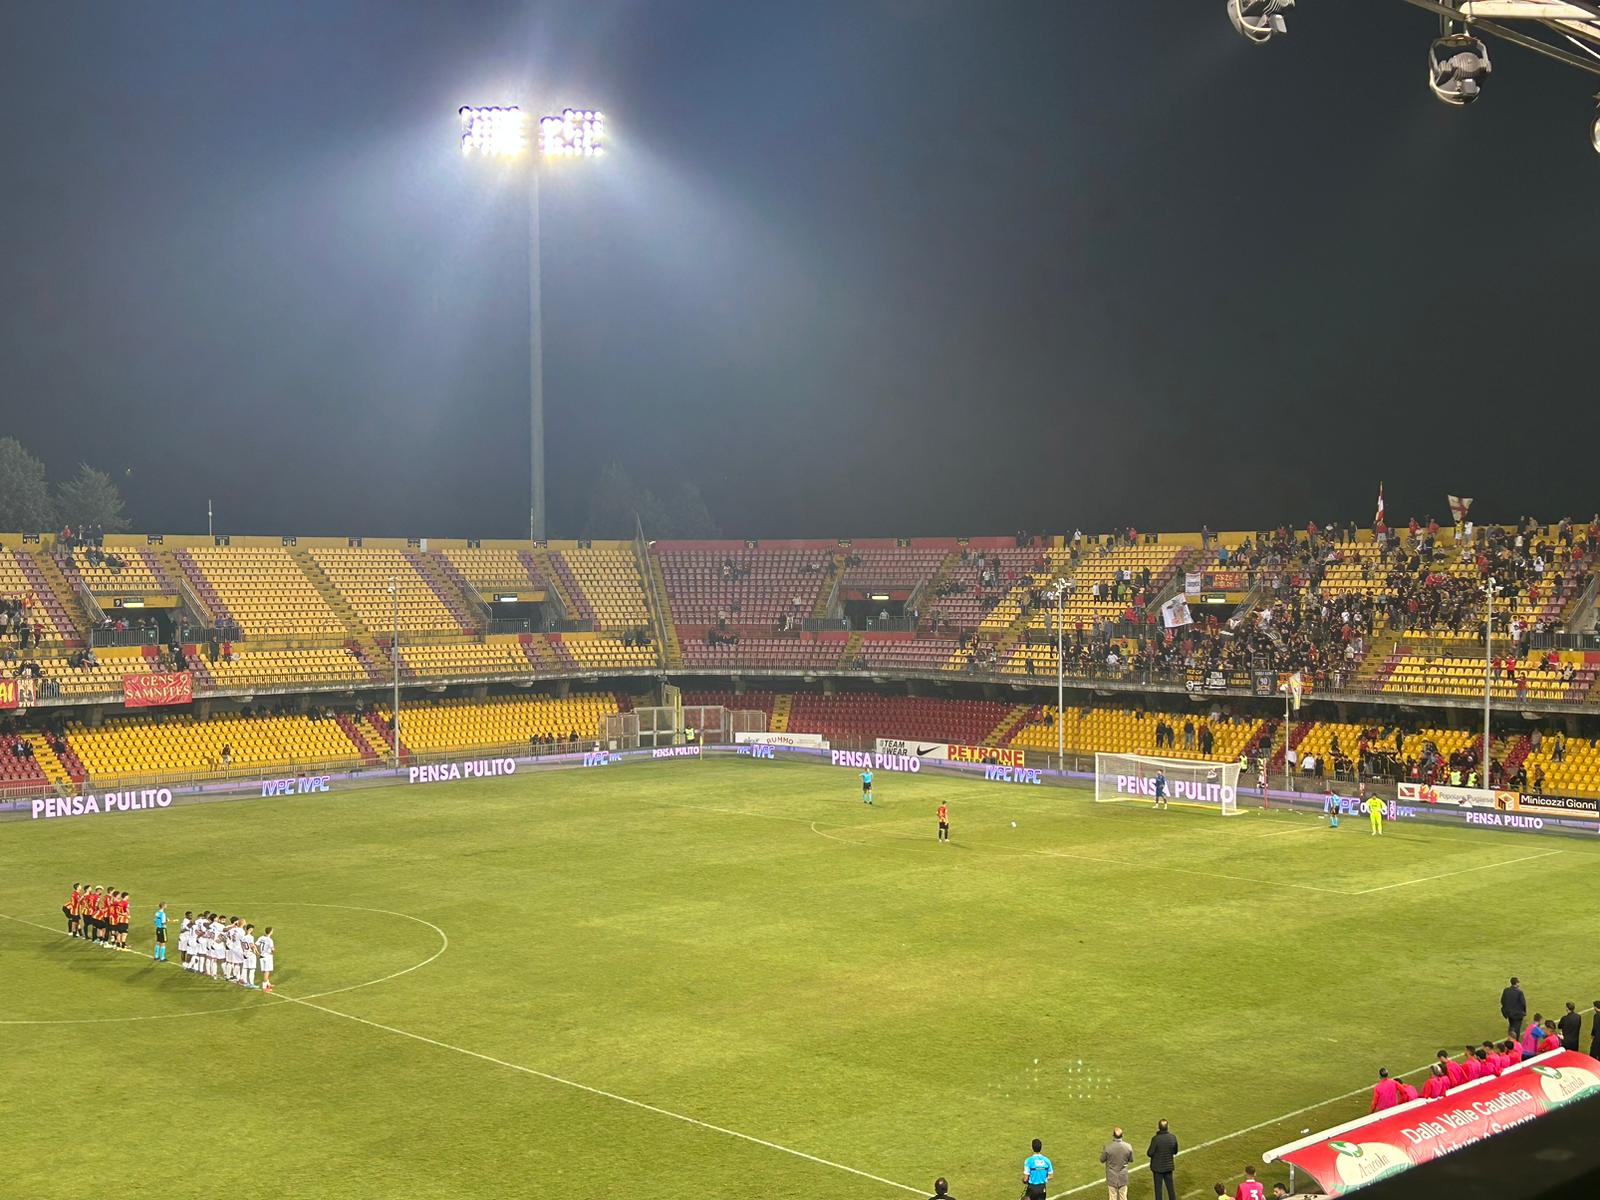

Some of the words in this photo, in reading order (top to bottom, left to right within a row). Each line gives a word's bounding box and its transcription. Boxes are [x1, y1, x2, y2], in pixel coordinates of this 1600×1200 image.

[140, 674, 174, 687] GENS
[126, 684, 190, 700] SAMNITES
[652, 747, 674, 758] PENSA
[675, 746, 700, 755] PULITO
[884, 740, 905, 748] TEAM
[886, 747, 908, 756] WEAR
[831, 749, 873, 768] PENSA
[875, 753, 921, 773] PULITO
[948, 745, 1024, 768] PETRONE
[409, 763, 461, 784] PENSA
[464, 757, 516, 778] PULITO
[985, 765, 1012, 782] IVPC
[1013, 767, 1042, 785] IVPC
[261, 779, 296, 797] IVPC
[298, 775, 331, 793] IVPC
[1174, 780, 1235, 803] PULITO
[32, 795, 100, 819] PENSA
[104, 788, 172, 812] PULITO
[1521, 794, 1565, 807] Minicozzi
[1566, 798, 1597, 810] Gianni
[1466, 811, 1503, 826] PENSA
[1504, 814, 1543, 829] PULITO
[1400, 1121, 1447, 1144] Dalla
[1436, 1109, 1480, 1129] Valle
[1472, 1088, 1533, 1116] Caudina
